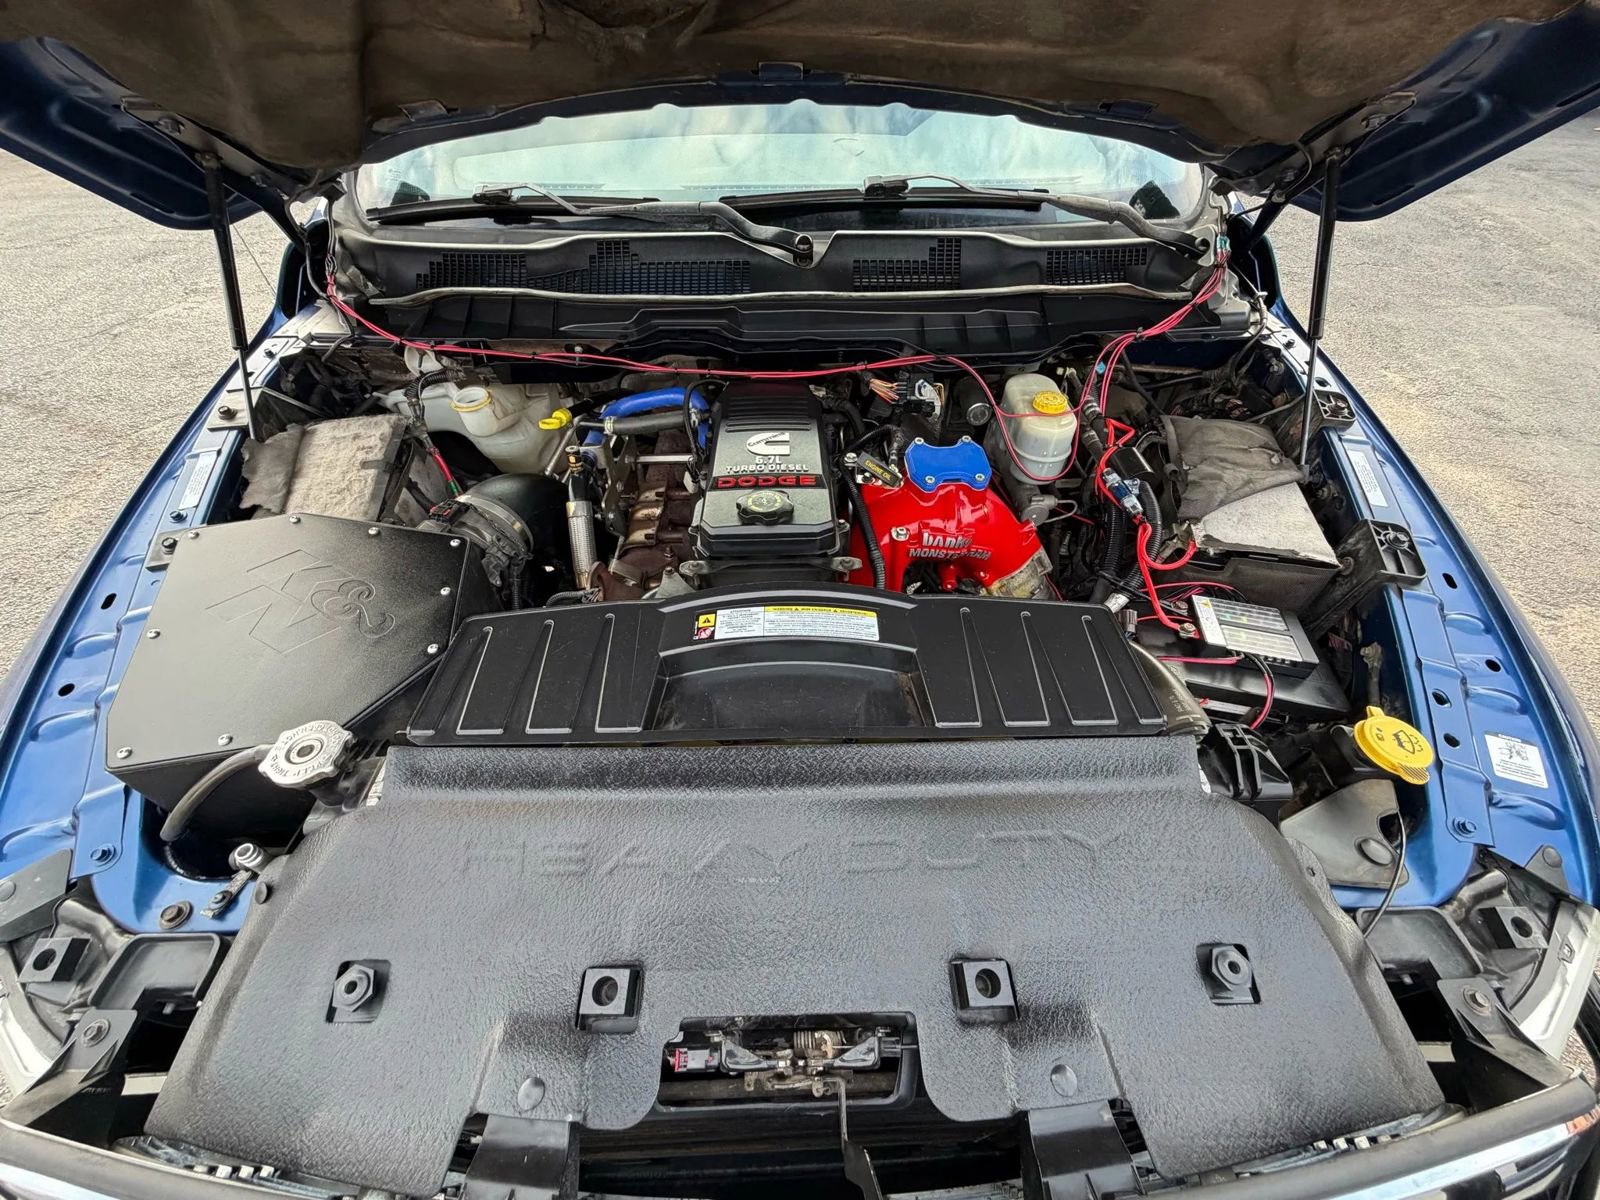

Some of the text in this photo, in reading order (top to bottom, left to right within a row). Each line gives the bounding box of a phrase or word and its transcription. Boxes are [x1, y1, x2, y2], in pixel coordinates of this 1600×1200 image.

[755, 455, 782, 465] 6.7L
[726, 463, 809, 473] TURBO DIESEL
[717, 475, 817, 488] DODGE
